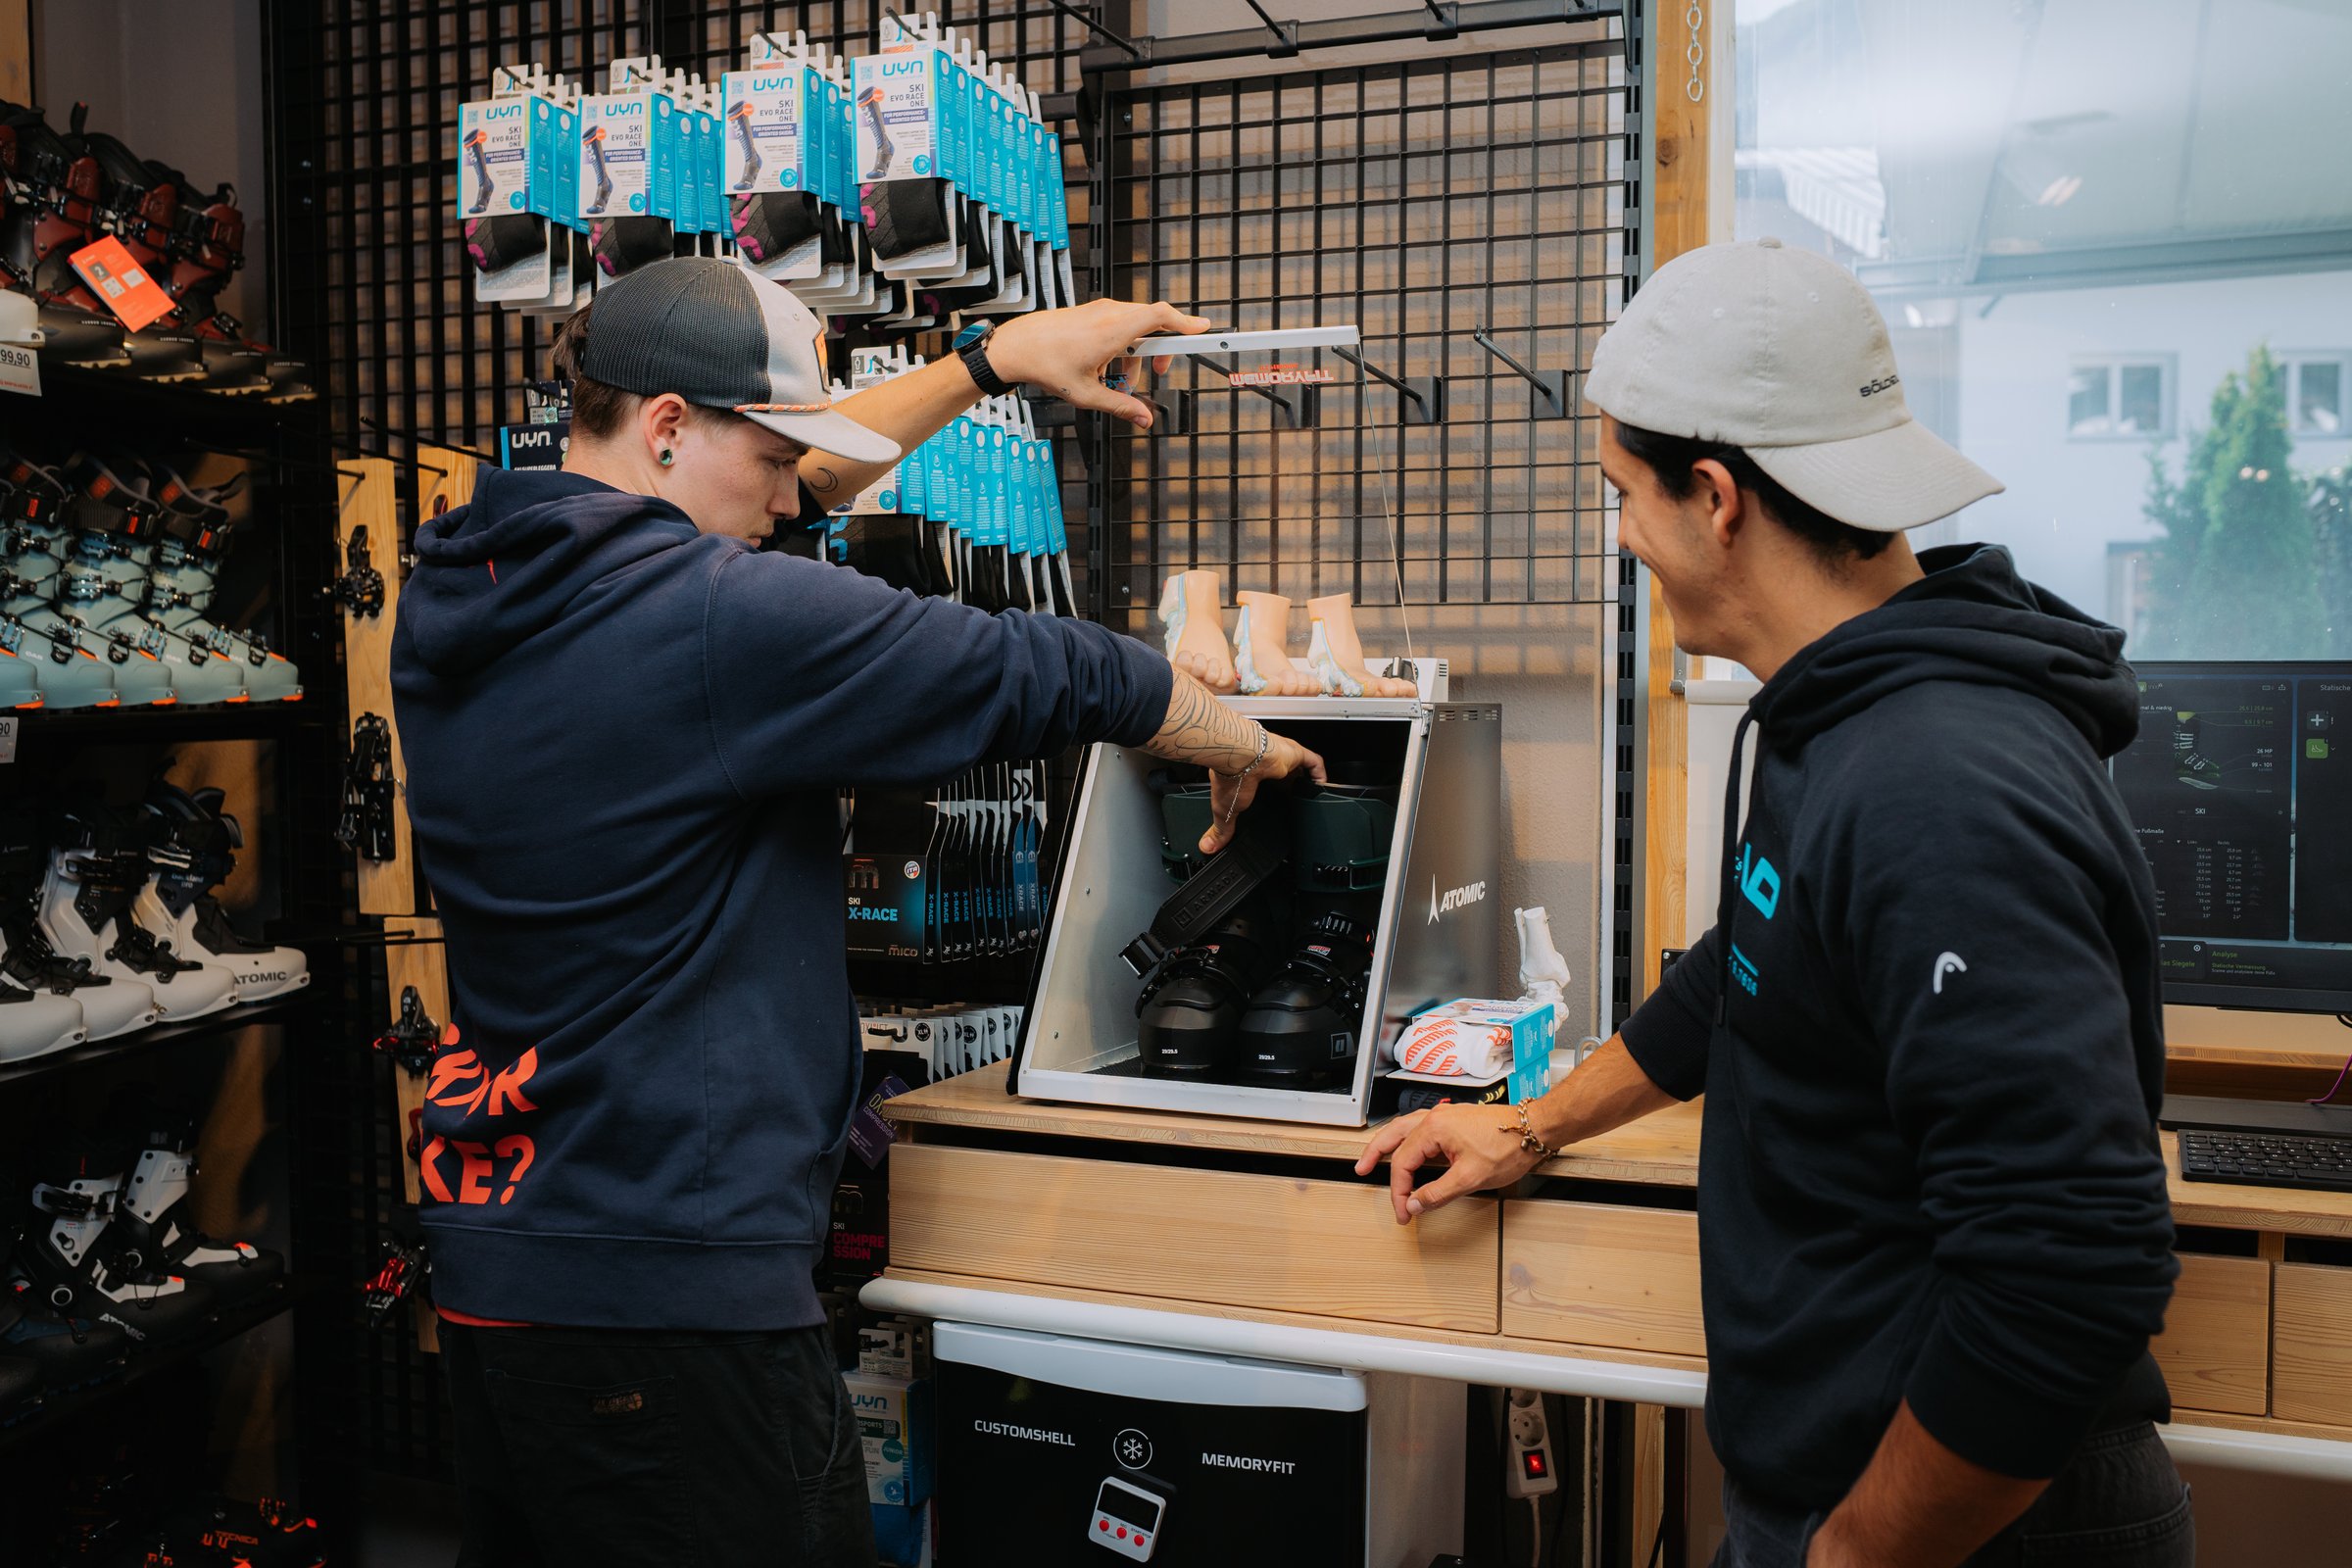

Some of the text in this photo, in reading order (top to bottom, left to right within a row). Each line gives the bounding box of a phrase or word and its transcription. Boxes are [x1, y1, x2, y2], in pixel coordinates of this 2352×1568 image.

[1195, 870, 1238, 910] ARMADA
[1440, 881, 1485, 913] ATOMIC
[848, 907, 898, 921] X-RACE
[863, 1107, 894, 1138] COMPRESSION
[833, 1233, 886, 1248] COMPRE
[833, 1246, 871, 1260] SSION
[974, 1420, 1075, 1446] CUSTOMSHELL
[1202, 1453, 1295, 1474] MEMORYFIT
